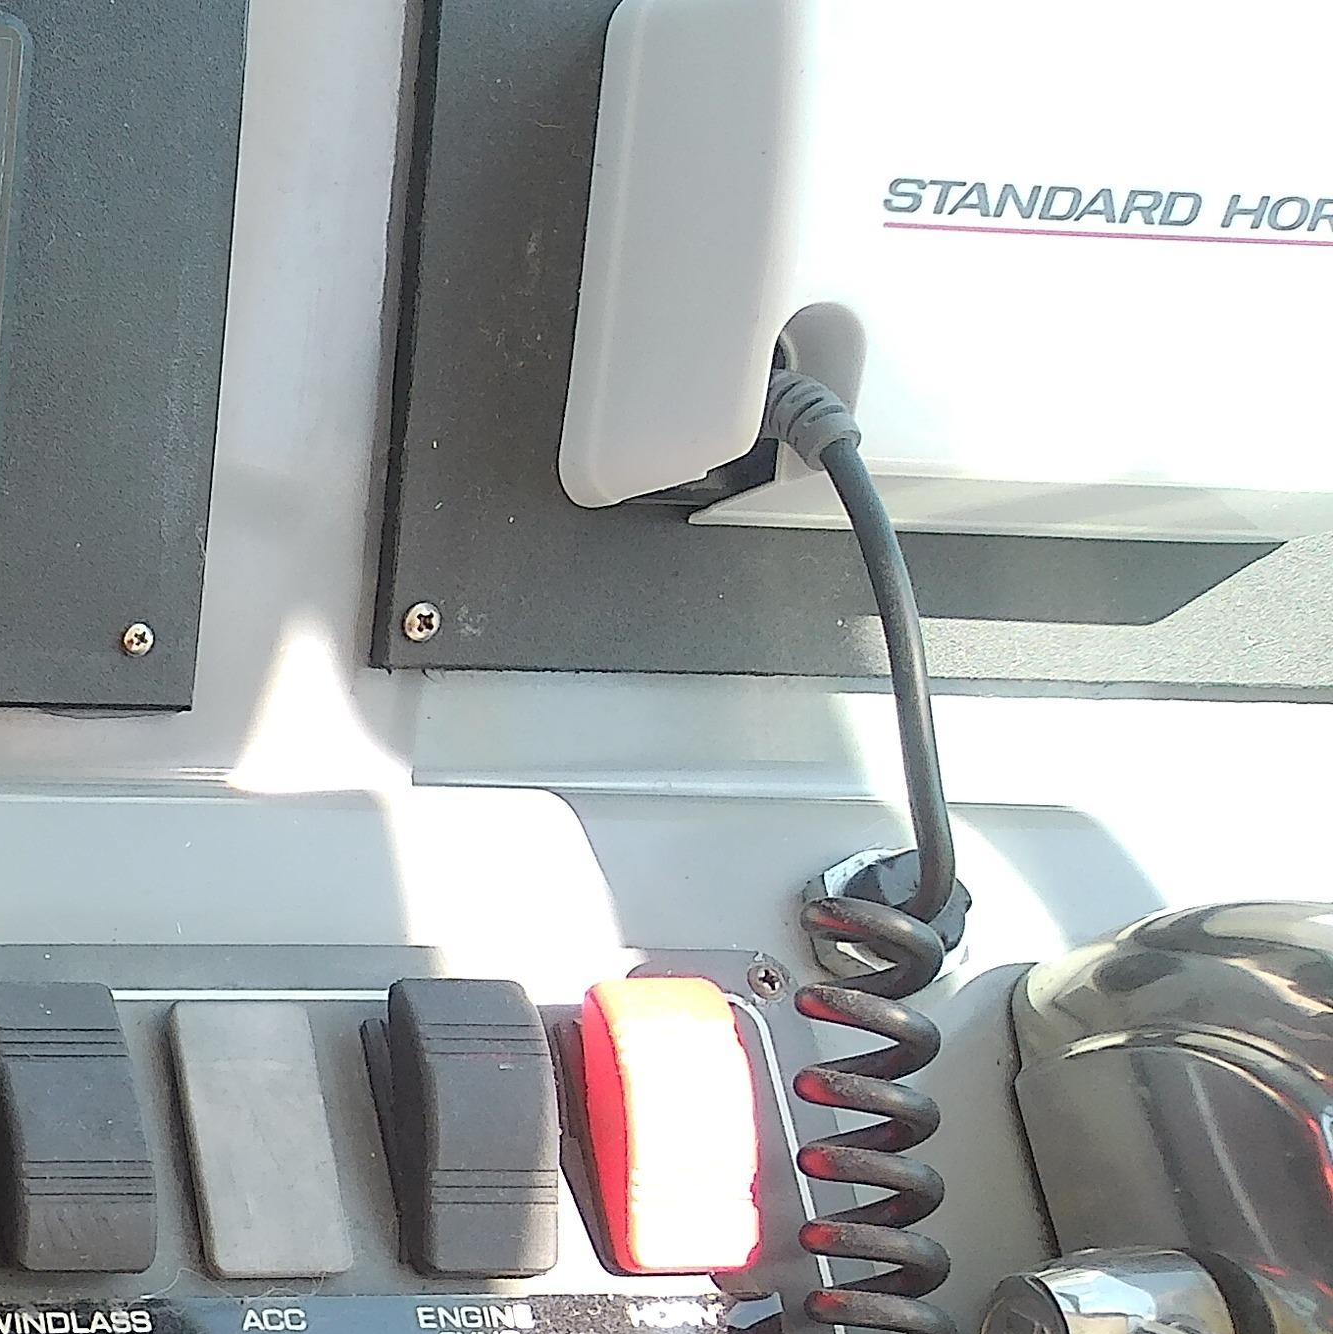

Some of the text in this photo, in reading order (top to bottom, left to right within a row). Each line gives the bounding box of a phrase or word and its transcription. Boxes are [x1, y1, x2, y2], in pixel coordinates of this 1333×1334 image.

[883, 178, 1203, 227] STANDARD
[242, 1308, 307, 1331] ACC
[416, 1305, 535, 1329] ENGINE
